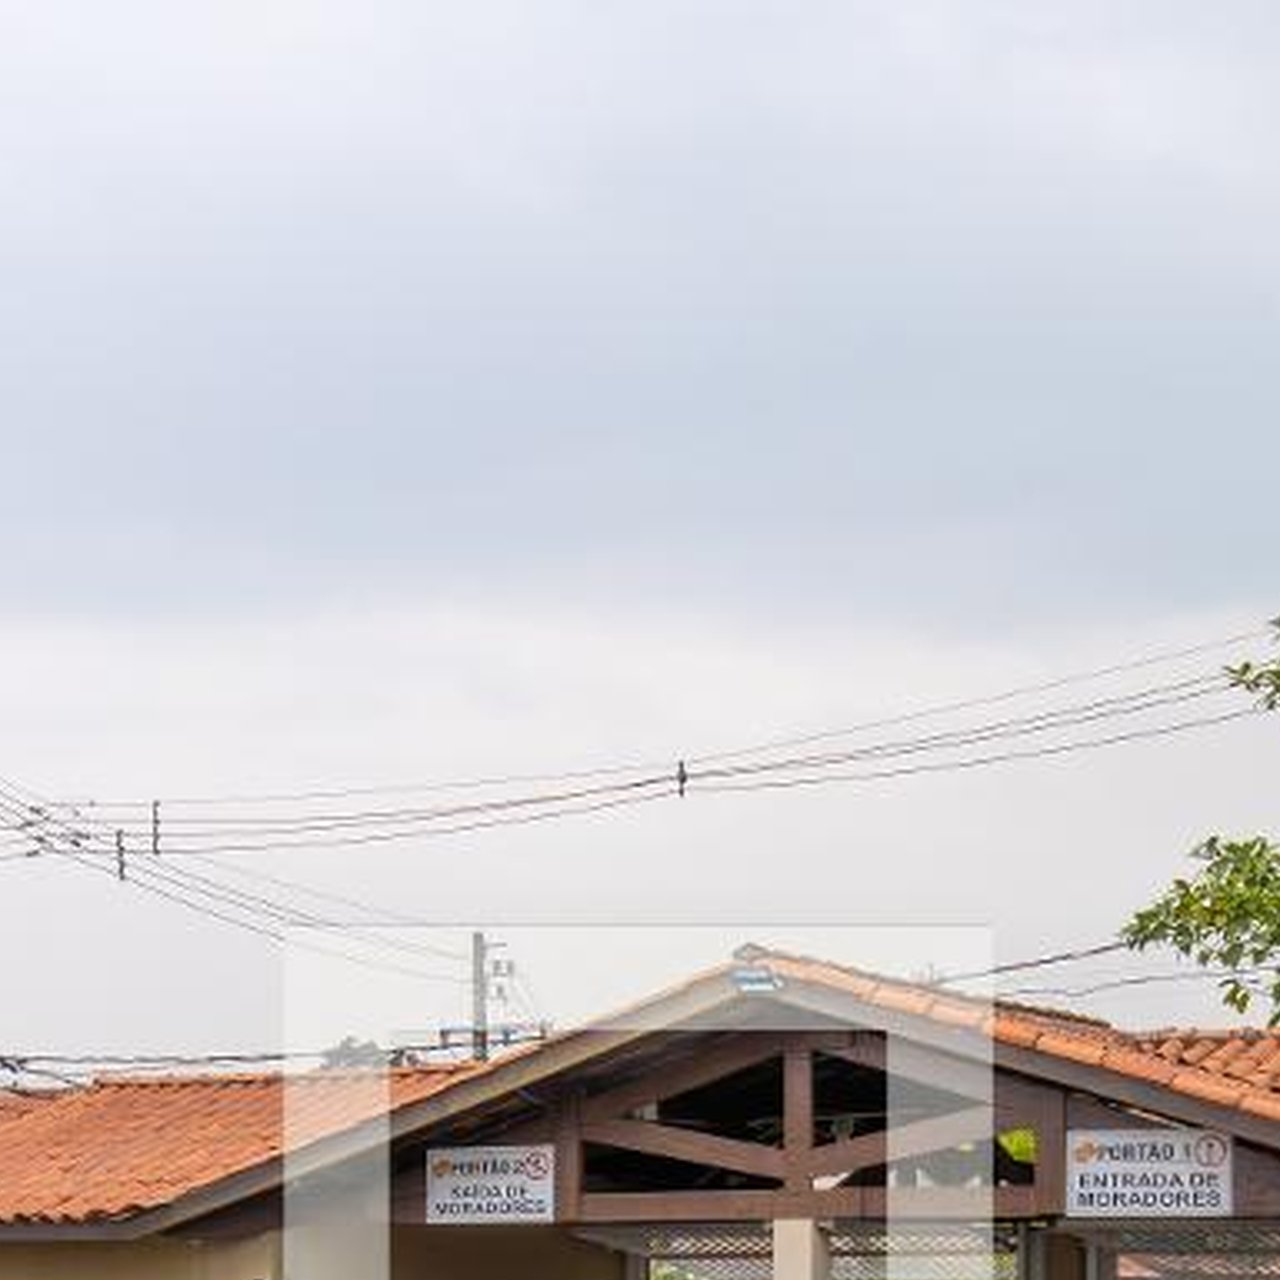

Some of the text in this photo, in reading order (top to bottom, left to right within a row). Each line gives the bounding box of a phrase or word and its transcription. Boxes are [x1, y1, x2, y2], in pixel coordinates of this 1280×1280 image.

[1078, 1172, 1221, 1189] ENTRADA DE
[1076, 1190, 1221, 1208] MORADORES
